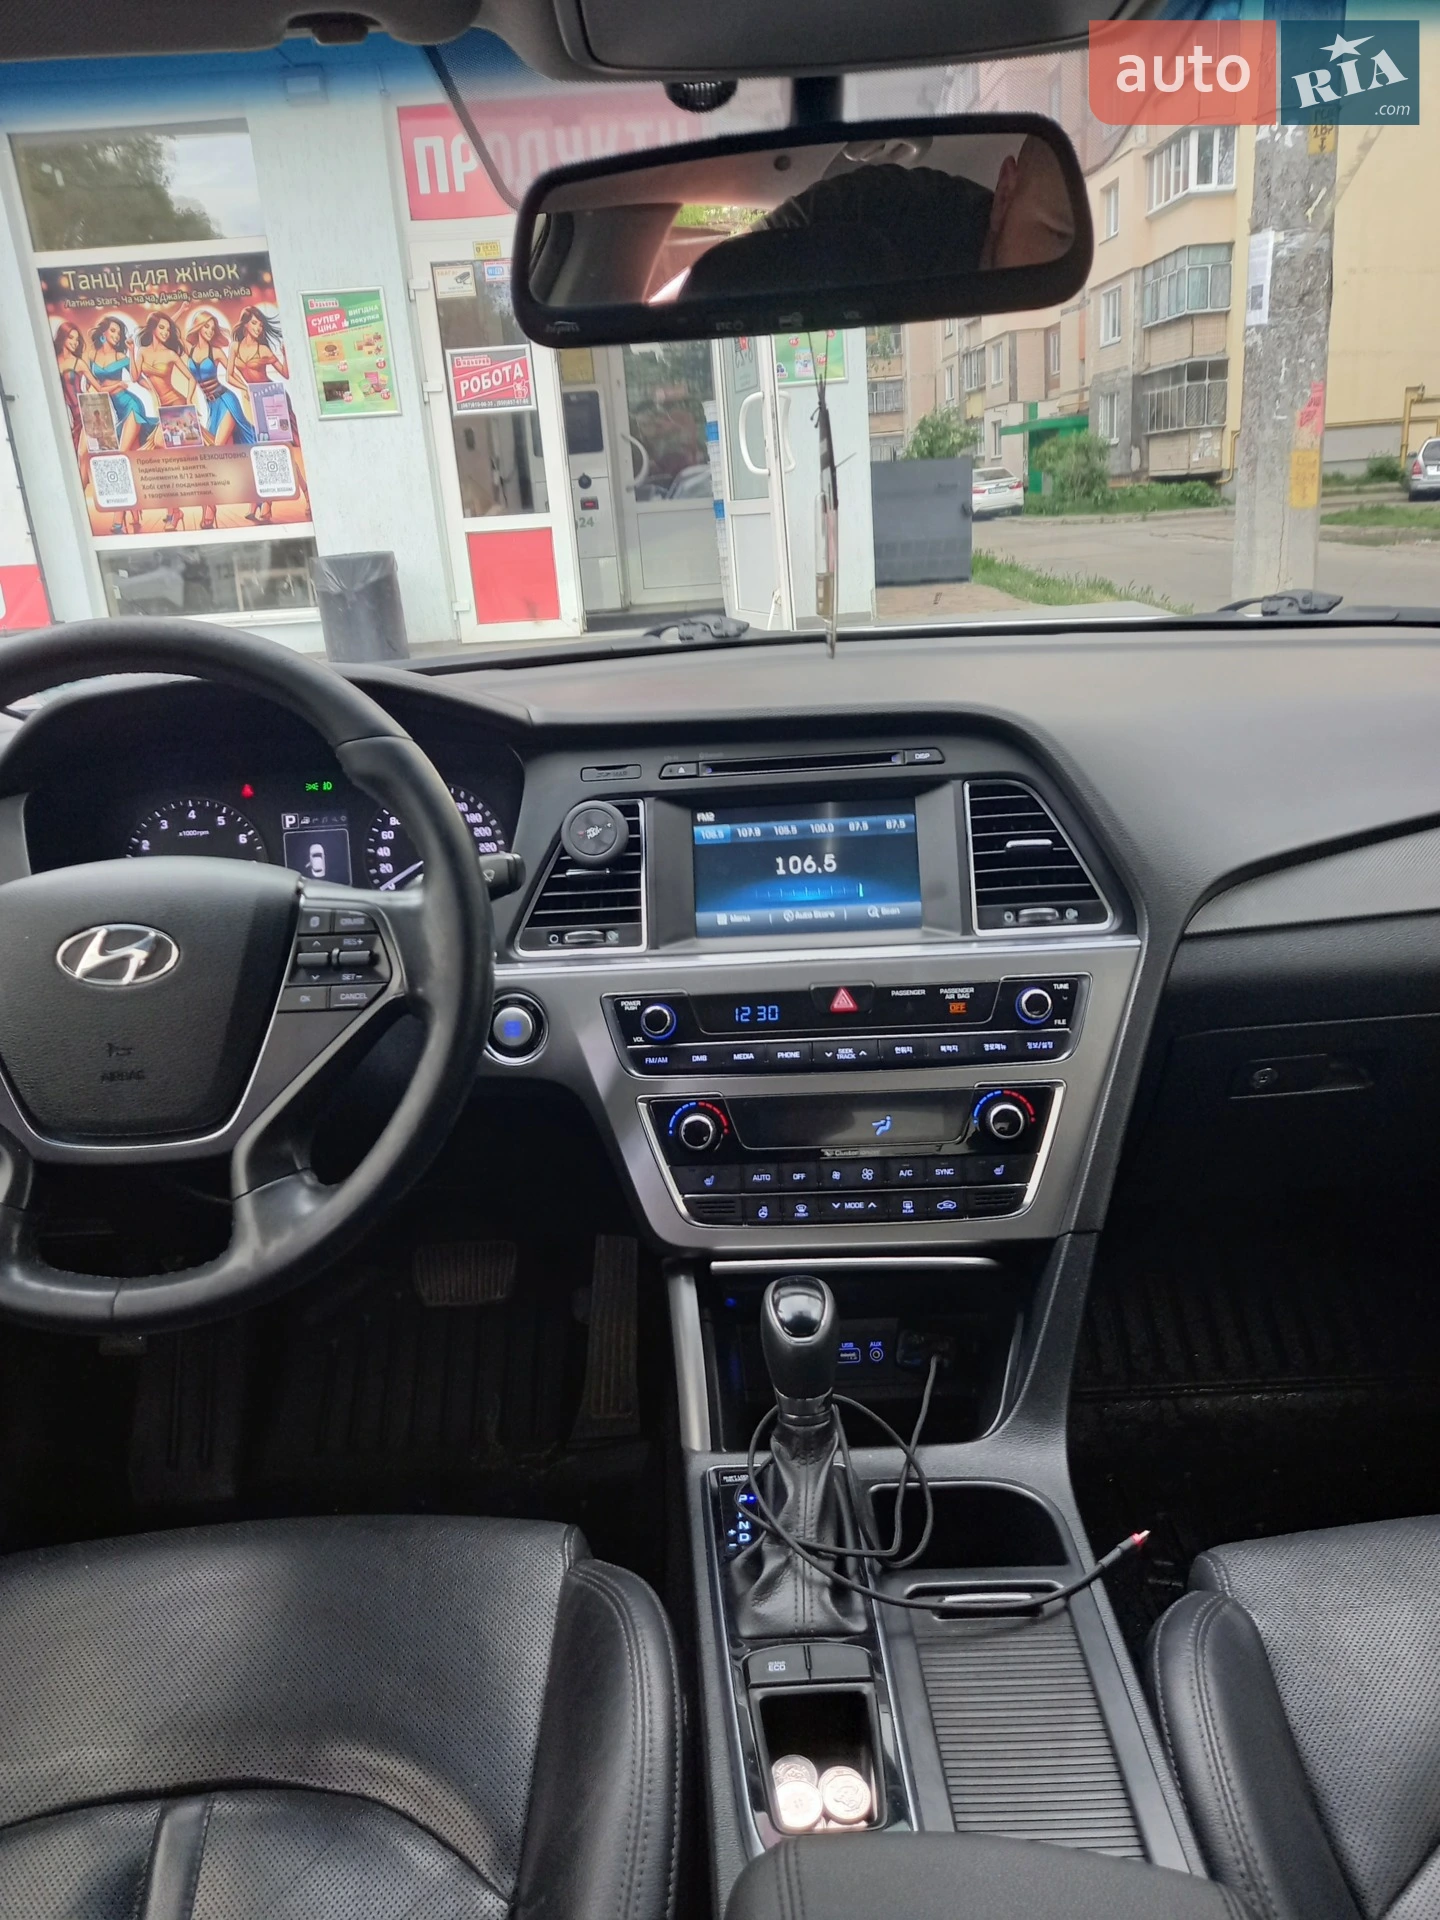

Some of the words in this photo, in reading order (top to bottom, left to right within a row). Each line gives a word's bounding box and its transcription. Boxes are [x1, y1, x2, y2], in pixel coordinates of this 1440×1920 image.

[63, 267, 123, 292] Танці
[130, 268, 169, 292] для
[175, 261, 240, 283] жінок
[65, 298, 95, 308] Латина
[96, 297, 120, 306] Stars,
[160, 291, 191, 303] Джайв,
[192, 289, 222, 300] Самба,
[223, 287, 251, 298] Румба
[348, 304, 379, 316] ВИГІДНА
[311, 313, 340, 327] СУПЕР
[350, 313, 380, 325] покупка
[317, 322, 338, 333] ЦІНА
[460, 362, 524, 398] РОБОТА
[188, 810, 196, 819] 4
[160, 820, 168, 829] 3
[217, 816, 226, 825] 5
[285, 816, 296, 828] P
[381, 831, 394, 839] 60
[473, 826, 492, 837] 200
[239, 833, 248, 843] 6
[141, 840, 150, 850] 2
[479, 842, 497, 853] 220
[377, 846, 391, 856] 40
[379, 863, 393, 873] 20
[775, 853, 838, 876] 106.5
[729, 915, 751, 923] Menu
[891, 989, 926, 997] PASSENGER
[939, 987, 975, 995] PASSENGER
[339, 992, 368, 1001] CANCEL
[949, 1002, 967, 1013] OFF
[1054, 1018, 1067, 1026] FILE
[691, 1054, 708, 1063] DMB
[733, 1052, 755, 1061] MEDIA
[777, 1050, 801, 1059] PHONE
[645, 1056, 668, 1064] FM/AM
[792, 1172, 806, 1181] OFF
[899, 1169, 913, 1178] A/C
[935, 1168, 954, 1177] SYNC
[752, 1173, 771, 1182] AUTO
[844, 1201, 865, 1209] MODE
[739, 1494, 748, 1503] P
[739, 1521, 750, 1530] N
[739, 1533, 751, 1542] D
